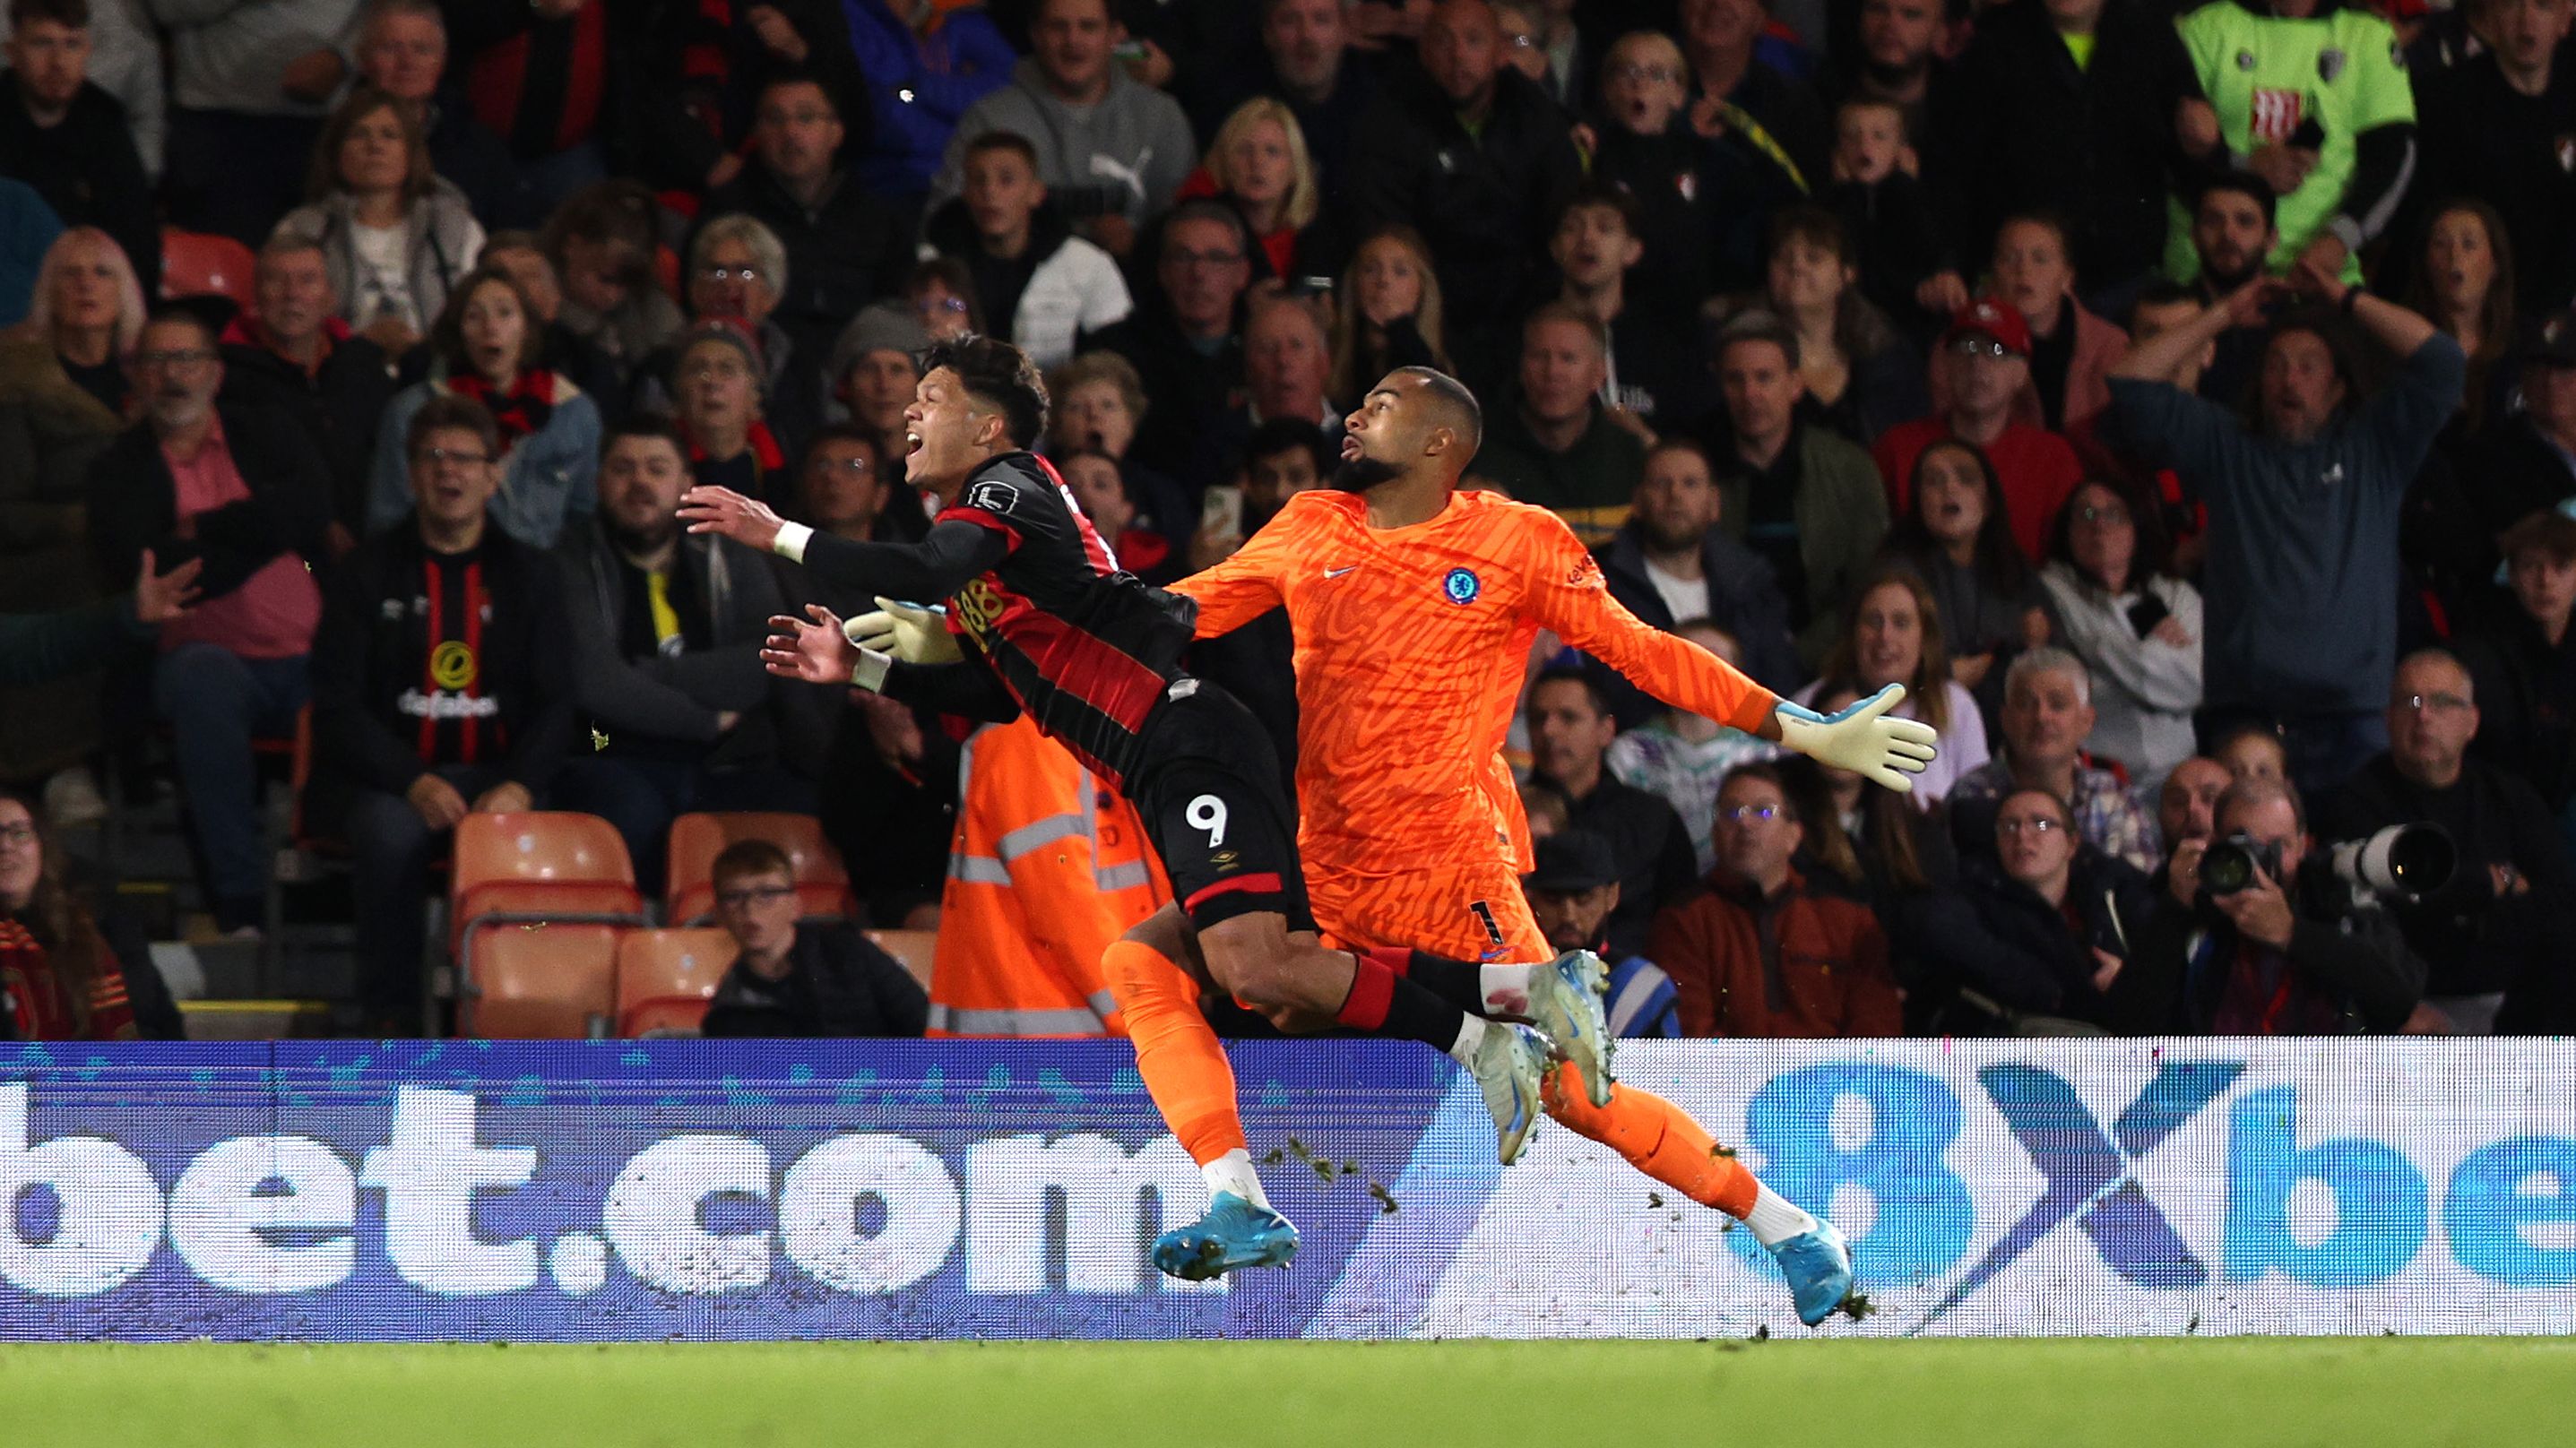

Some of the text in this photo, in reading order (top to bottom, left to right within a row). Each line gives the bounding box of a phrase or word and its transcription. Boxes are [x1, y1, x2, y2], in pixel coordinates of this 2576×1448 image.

[1186, 794, 1228, 848] 9
[1469, 900, 1504, 946] 1
[0, 1082, 1230, 1295] bet.com
